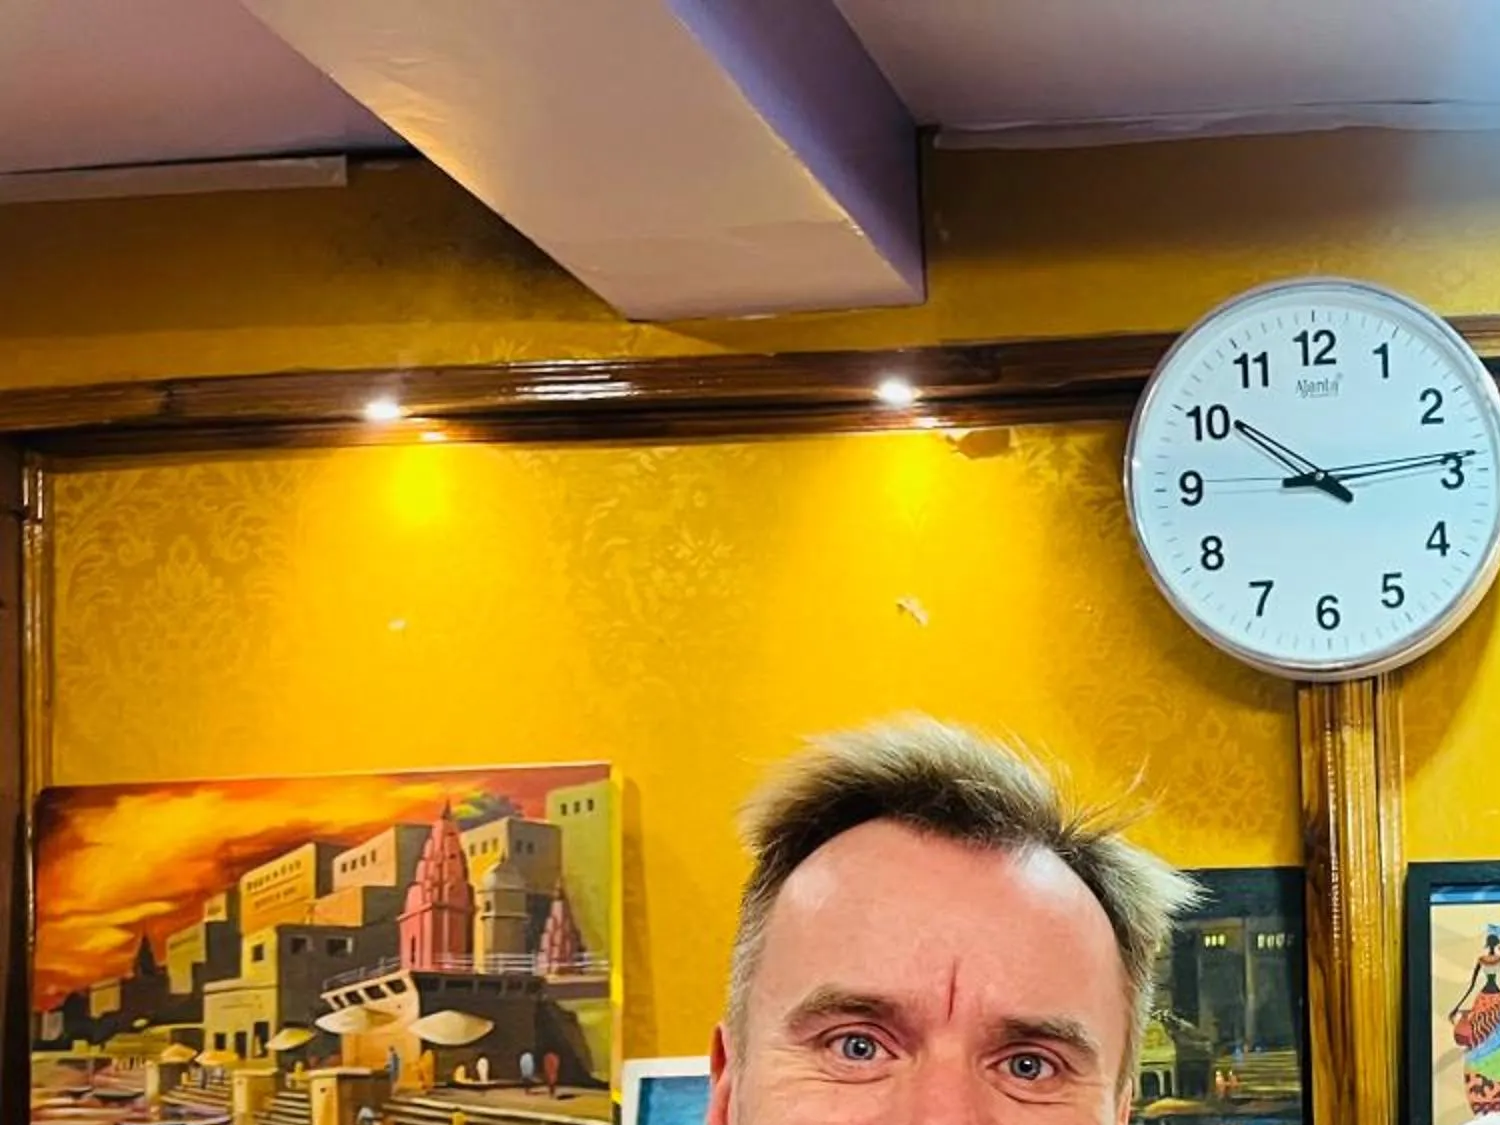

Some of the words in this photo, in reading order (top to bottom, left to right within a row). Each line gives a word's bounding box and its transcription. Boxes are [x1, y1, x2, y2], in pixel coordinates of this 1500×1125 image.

[1293, 329, 1337, 366] 12
[1372, 342, 1389, 379] 1
[1233, 351, 1270, 389] 11
[1186, 404, 1231, 441] 10
[1419, 387, 1445, 425] 2
[1179, 470, 1204, 506] 9
[1440, 452, 1465, 490] 3
[1200, 535, 1225, 571] 8
[1426, 520, 1451, 557] 4
[1248, 580, 1274, 617] 7
[1381, 572, 1405, 609] 5
[1316, 595, 1341, 630] 6
